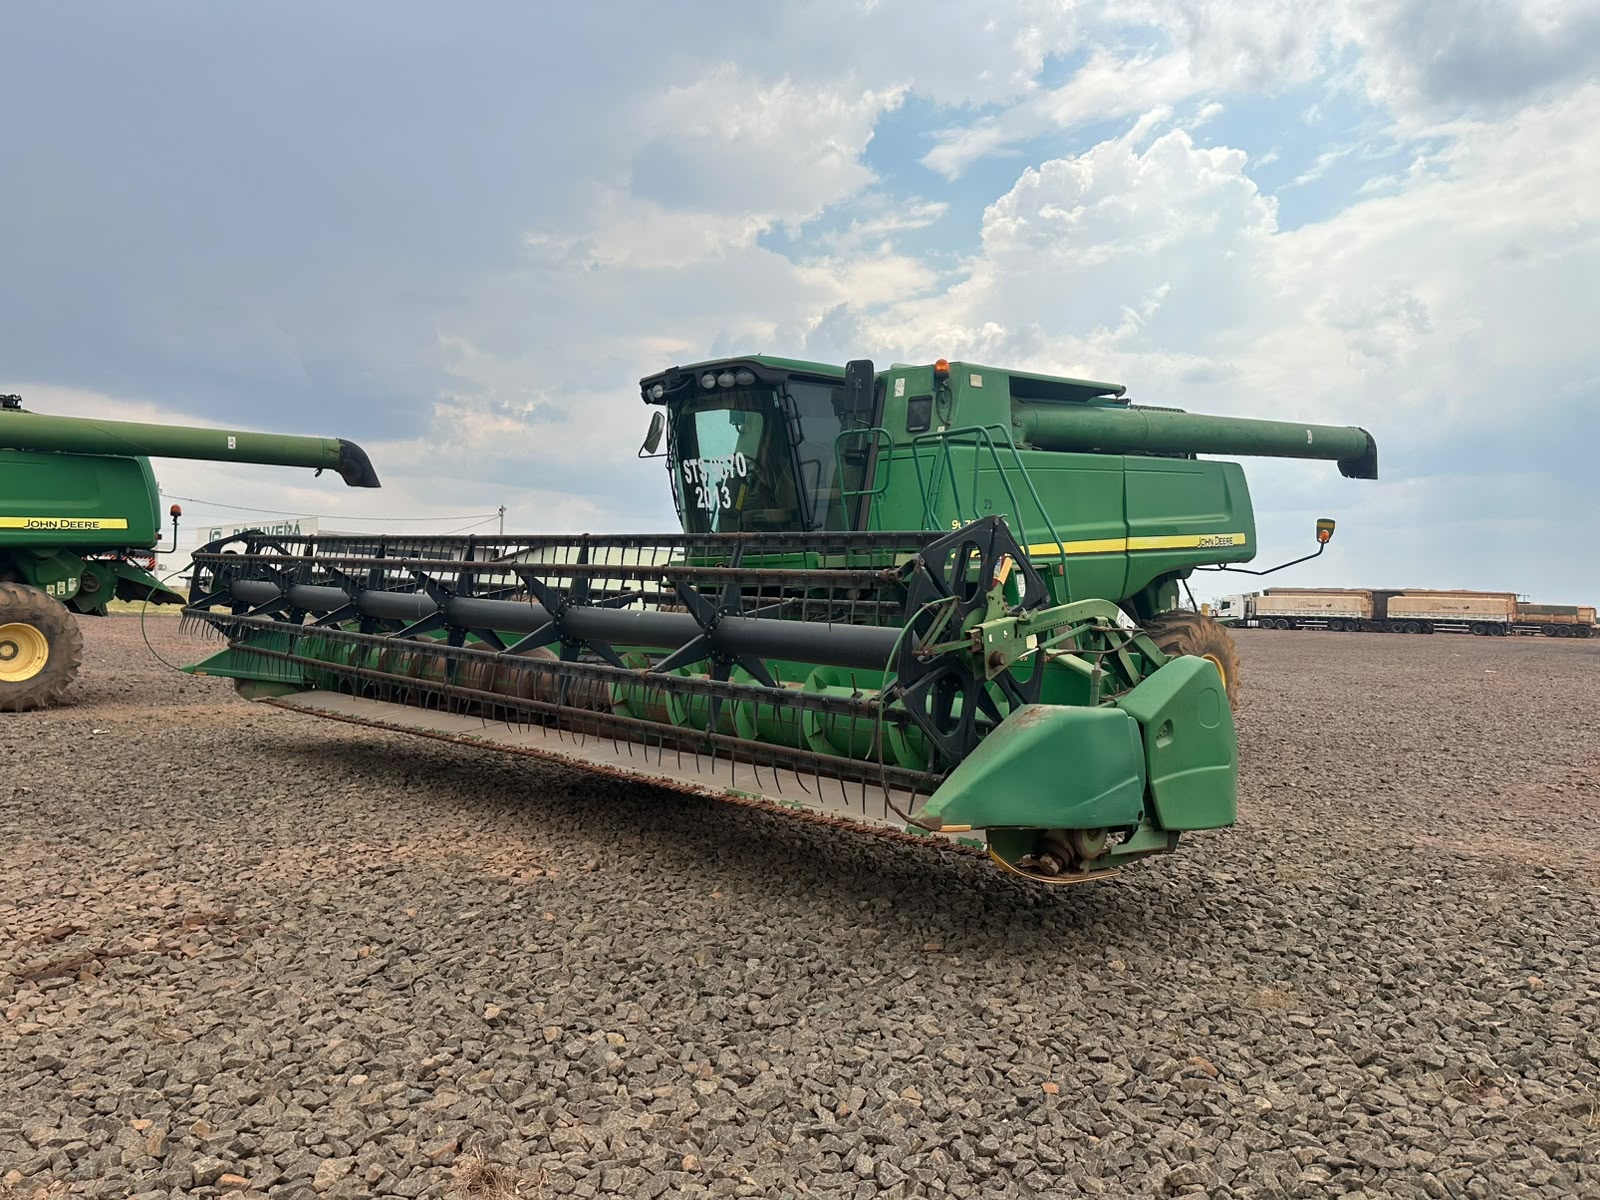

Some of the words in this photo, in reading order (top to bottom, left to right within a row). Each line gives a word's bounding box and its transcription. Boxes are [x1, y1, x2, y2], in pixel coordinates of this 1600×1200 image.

[683, 457, 708, 484] STS
[695, 486, 731, 509] 2013
[24, 519, 58, 528] JOHN
[60, 520, 100, 528] DEERE
[1197, 536, 1213, 547] JOHN
[1215, 535, 1233, 546] DEERE
